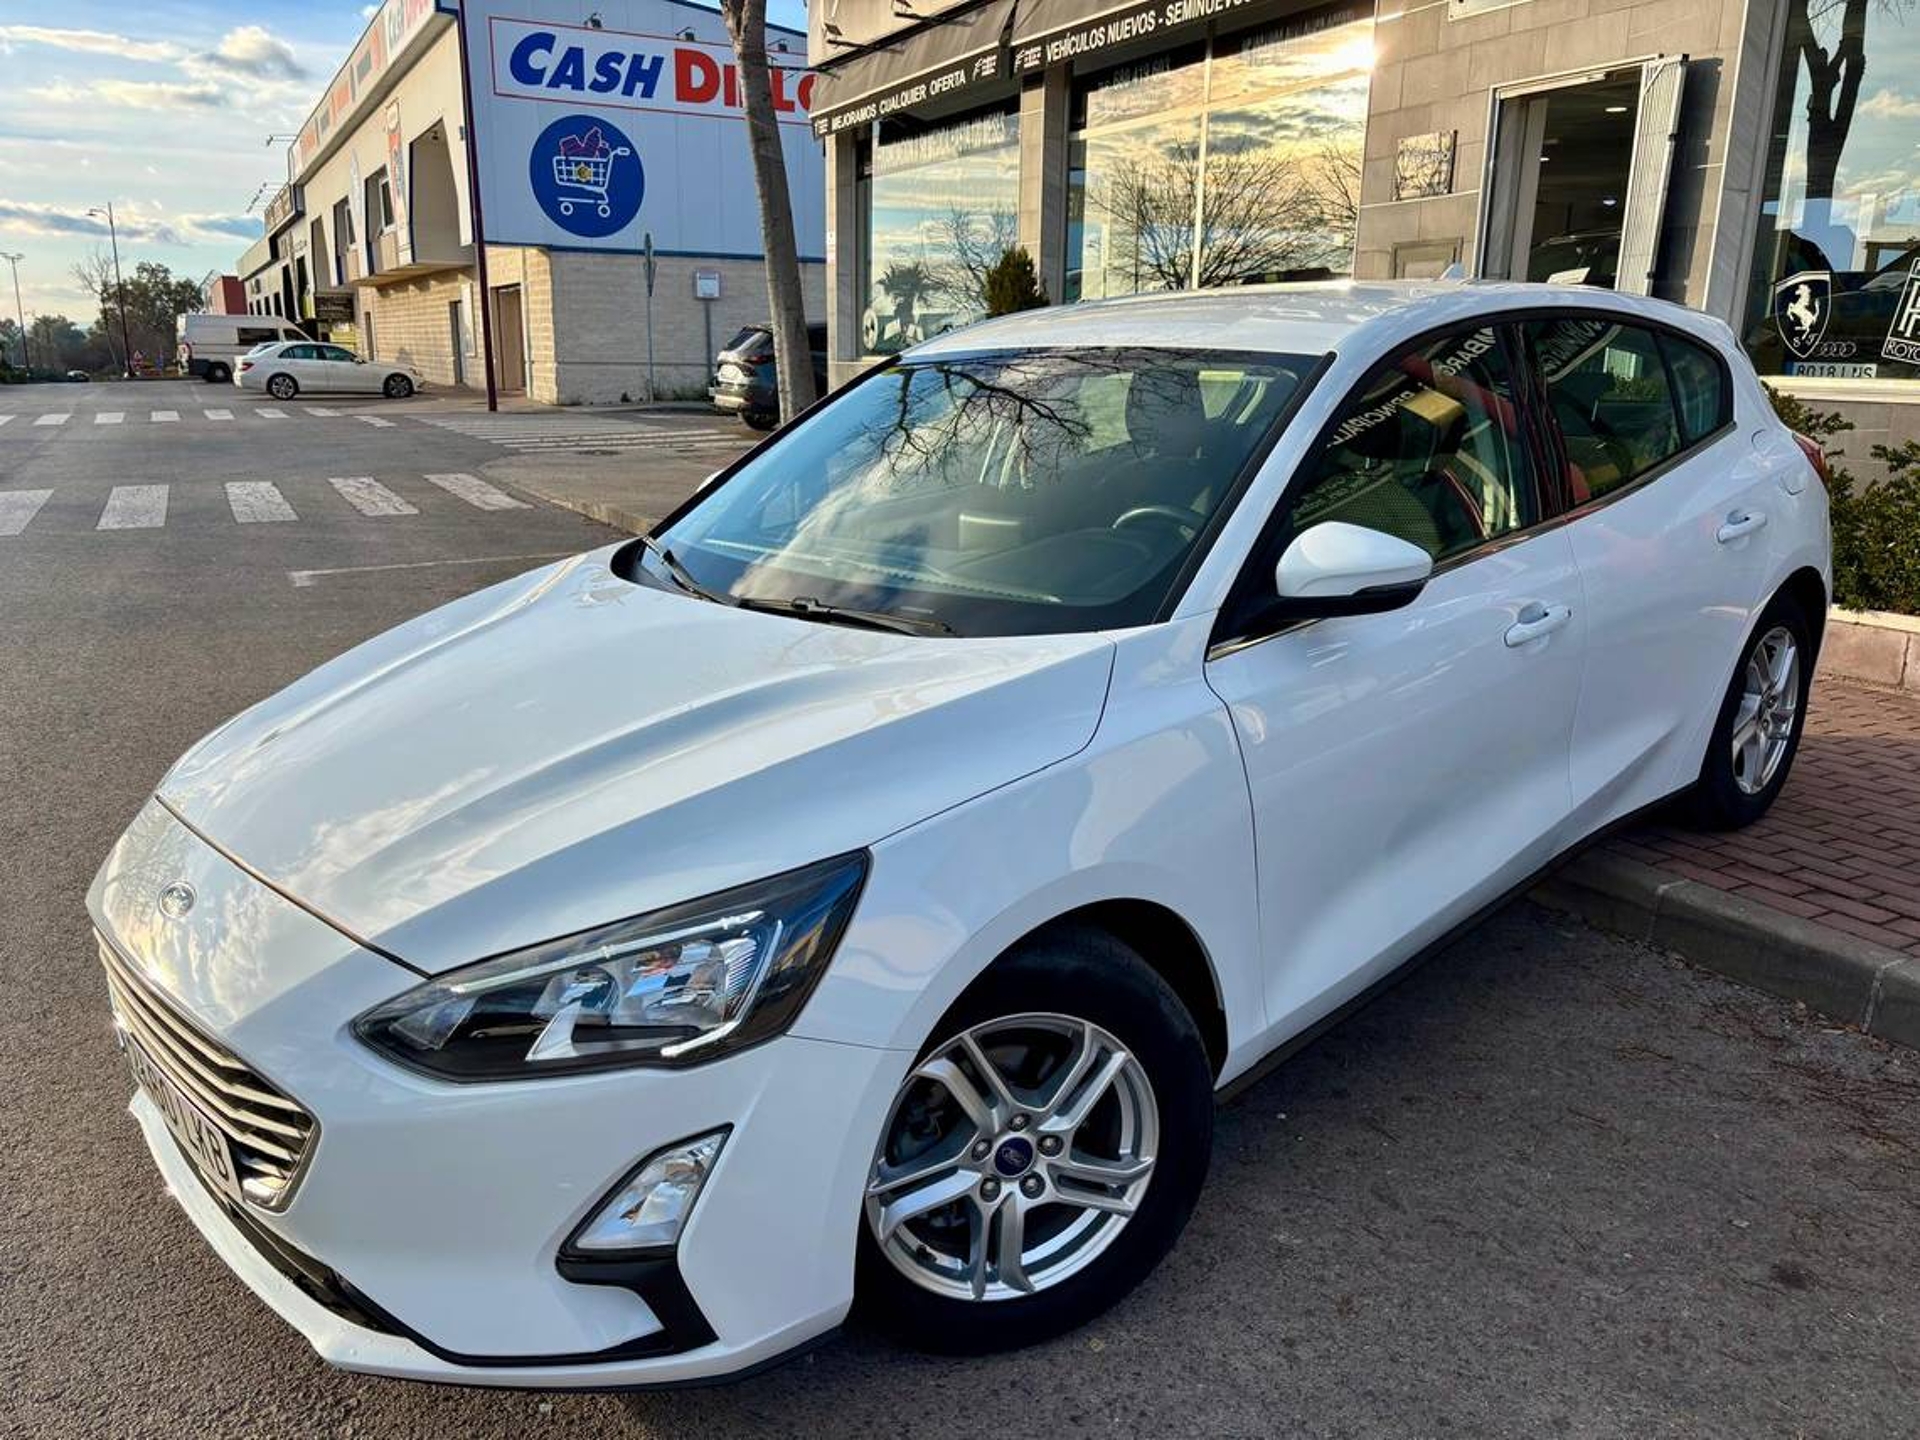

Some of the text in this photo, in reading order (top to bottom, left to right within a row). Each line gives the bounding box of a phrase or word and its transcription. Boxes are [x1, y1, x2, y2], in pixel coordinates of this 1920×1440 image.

[510, 31, 664, 99] CASH
[1045, 26, 1106, 63] VEHÍCULOS
[1106, 10, 1157, 42] NUEVOS
[831, 103, 877, 131] MEJORAMOS
[879, 84, 928, 114] CUALQUIER
[929, 68, 967, 95] OFERTA
